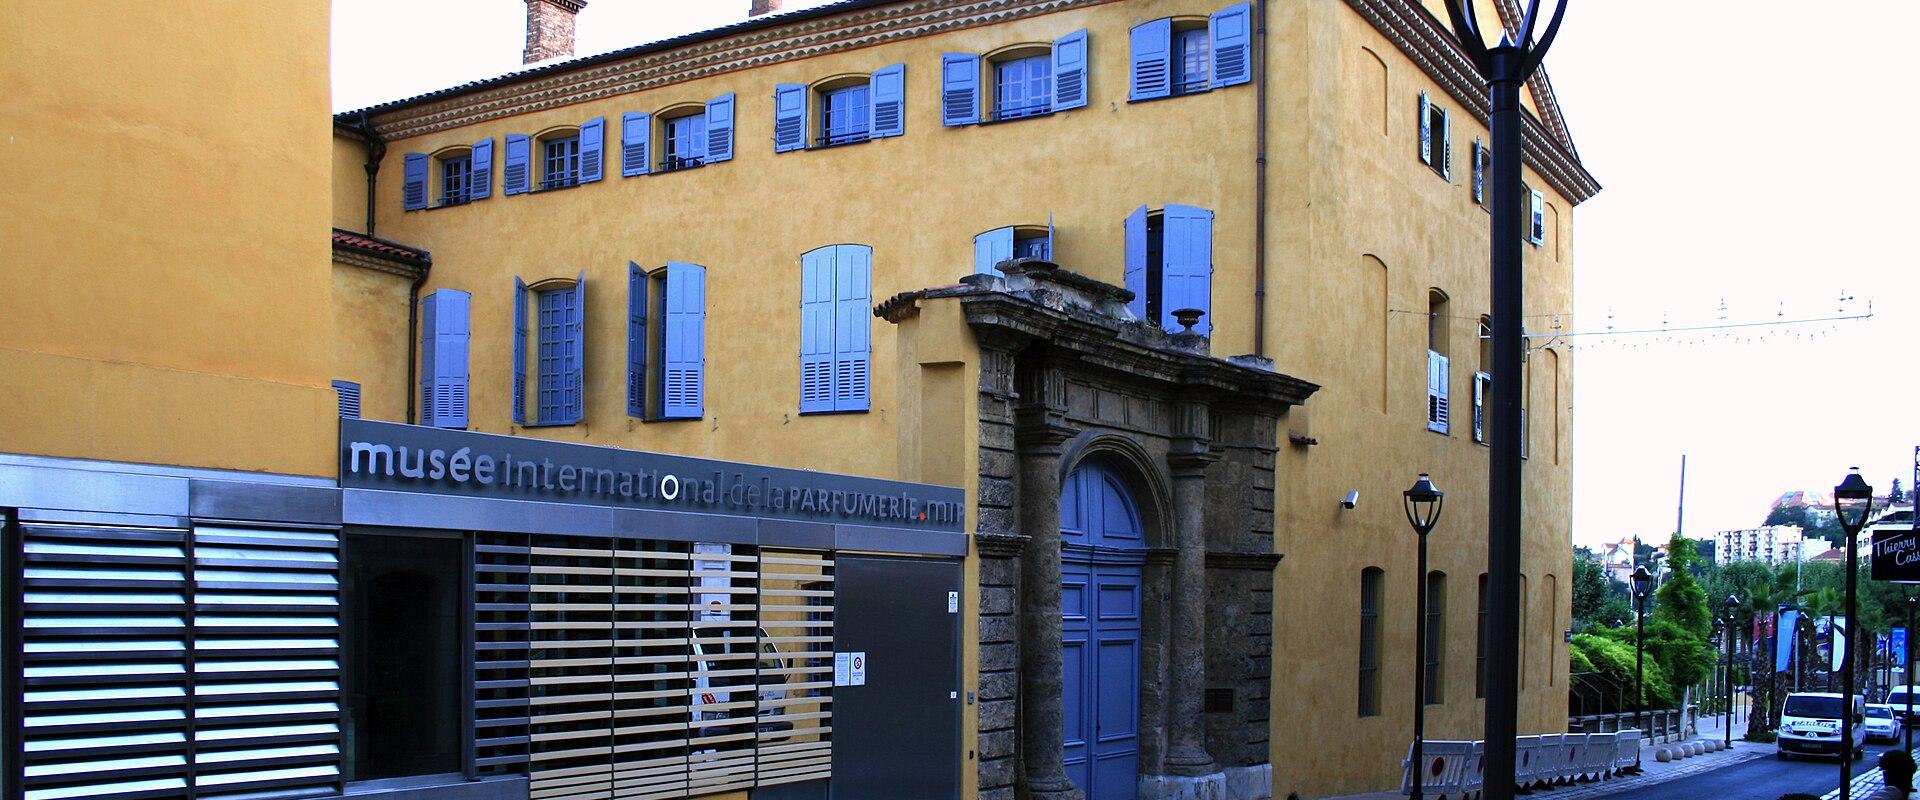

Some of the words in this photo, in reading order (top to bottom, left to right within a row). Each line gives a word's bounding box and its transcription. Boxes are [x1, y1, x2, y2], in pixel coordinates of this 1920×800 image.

[351, 441, 495, 485] musée
[504, 453, 724, 504] international
[731, 472, 761, 507] de
[766, 475, 785, 509] la
[1873, 533, 1916, 557] Thierry
